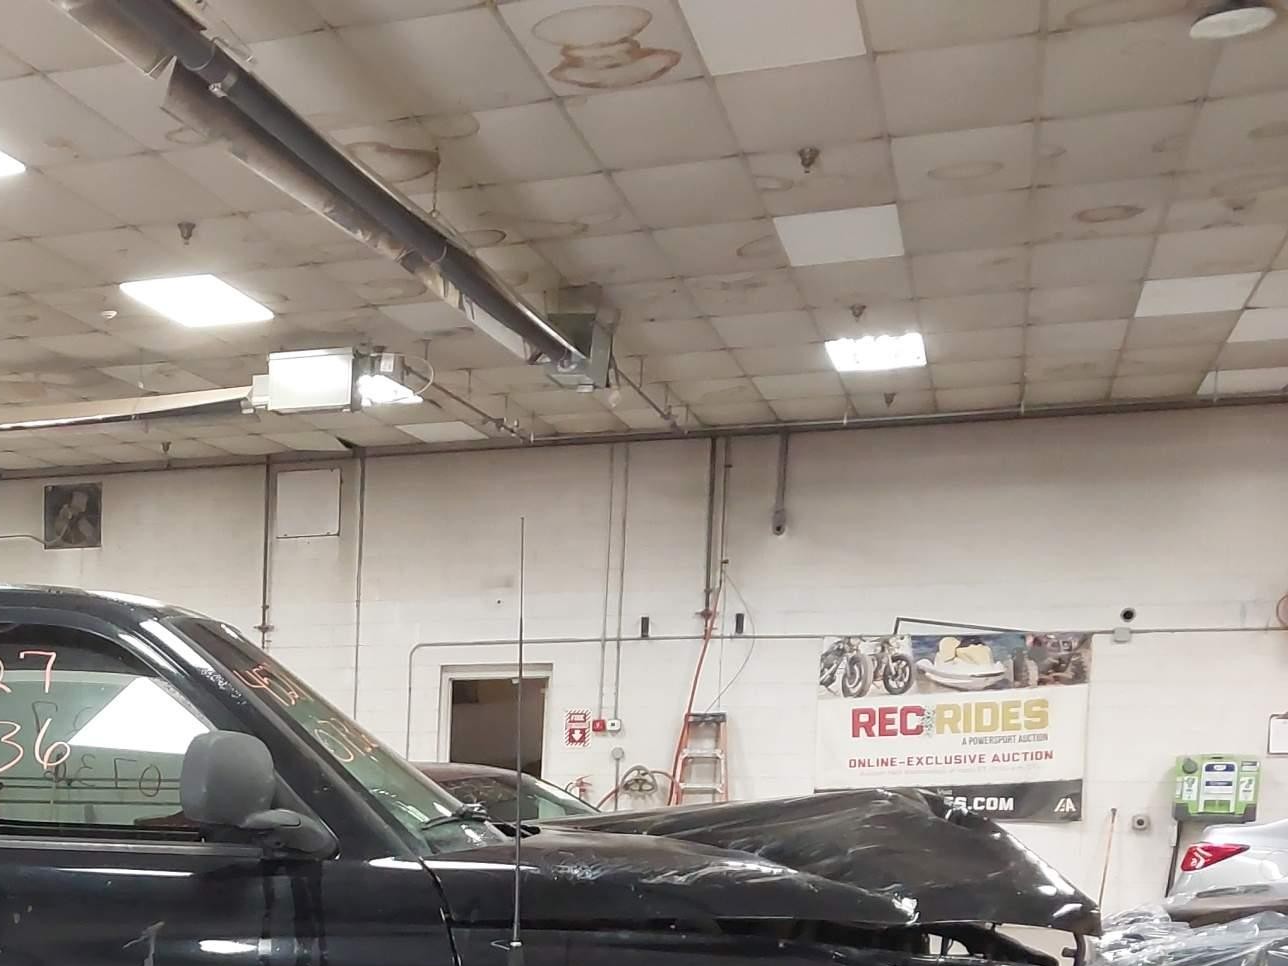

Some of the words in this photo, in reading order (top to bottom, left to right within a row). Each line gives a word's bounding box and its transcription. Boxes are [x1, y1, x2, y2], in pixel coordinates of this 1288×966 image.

[851, 706, 924, 738] REC
[935, 698, 1049, 735] RIDES
[969, 735, 1016, 745] POWERSPORT
[1018, 733, 1049, 743] AUCTION
[848, 754, 986, 769] ONLINE-EXCLUSIVE
[991, 751, 1054, 763] AUCTION
